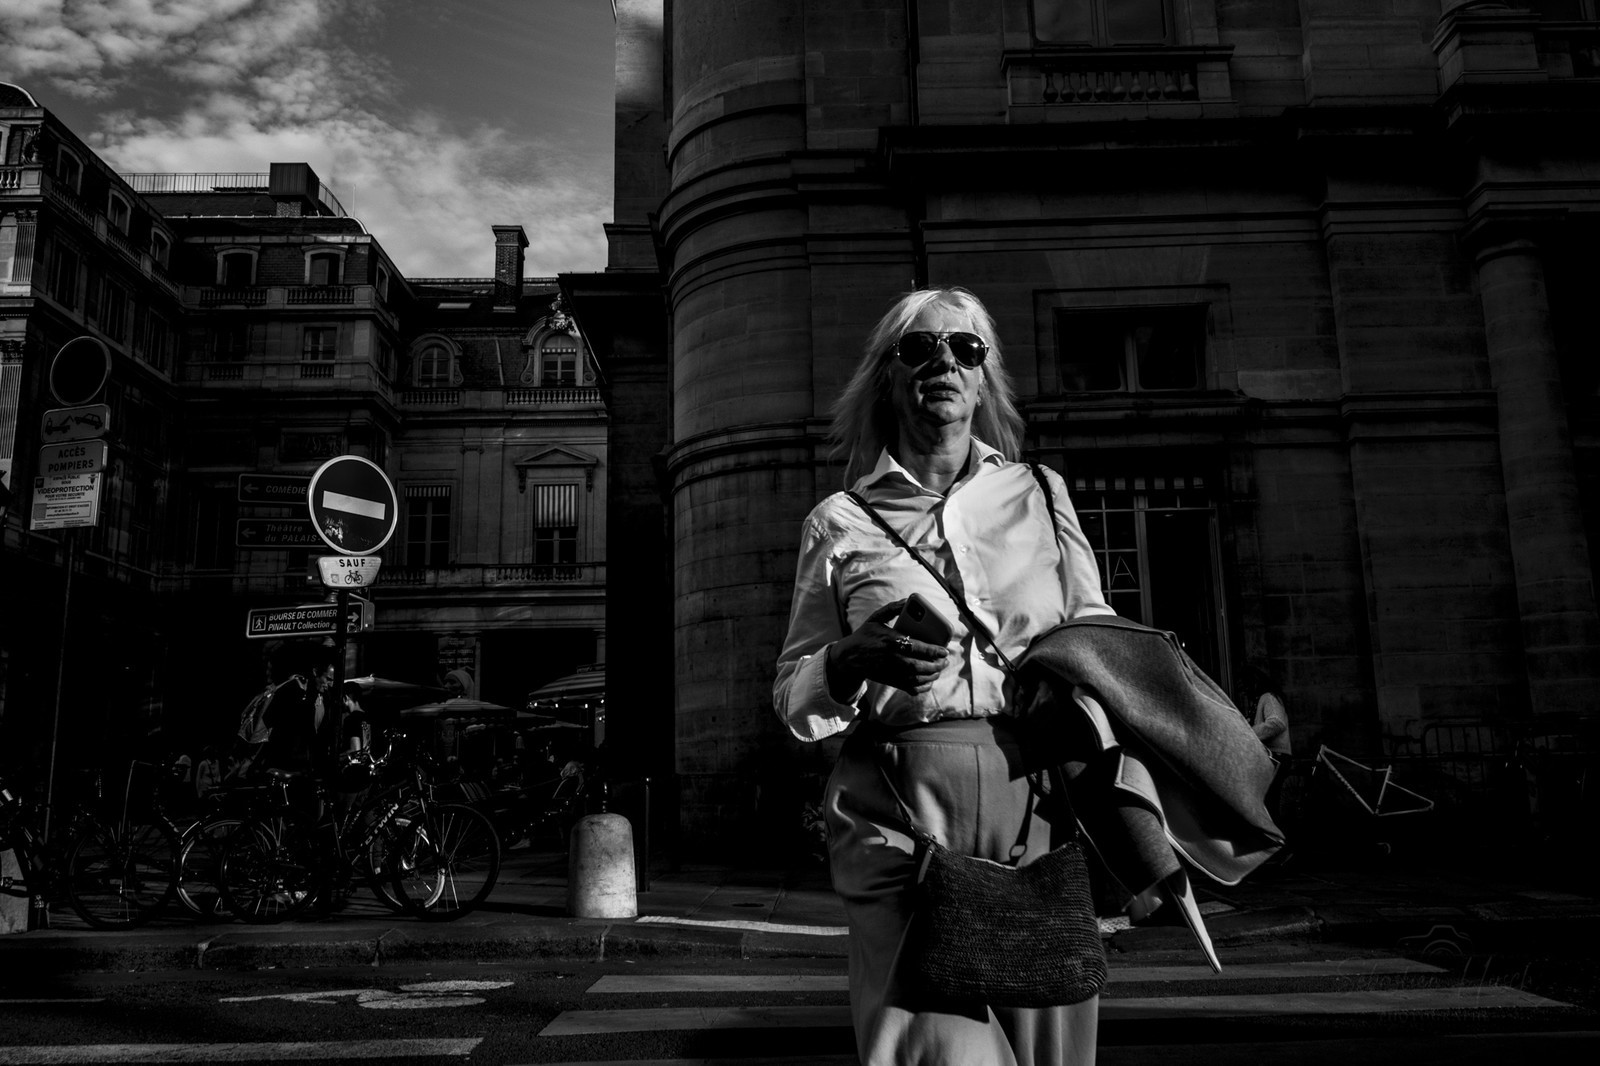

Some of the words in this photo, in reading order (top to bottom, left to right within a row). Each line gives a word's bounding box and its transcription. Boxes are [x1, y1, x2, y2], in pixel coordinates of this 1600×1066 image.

[57, 446, 86, 459] ACCÈS
[48, 459, 94, 473] POMPIERS
[265, 483, 308, 495] COMÉDIE
[266, 523, 303, 532] Théâtre
[264, 534, 276, 542] du
[339, 558, 366, 568] SAUF
[269, 611, 297, 621] BOURSE
[297, 610, 306, 619] DE
[306, 609, 338, 619] COMMER
[268, 622, 297, 631] PINAULT
[297, 620, 331, 630] Collection
